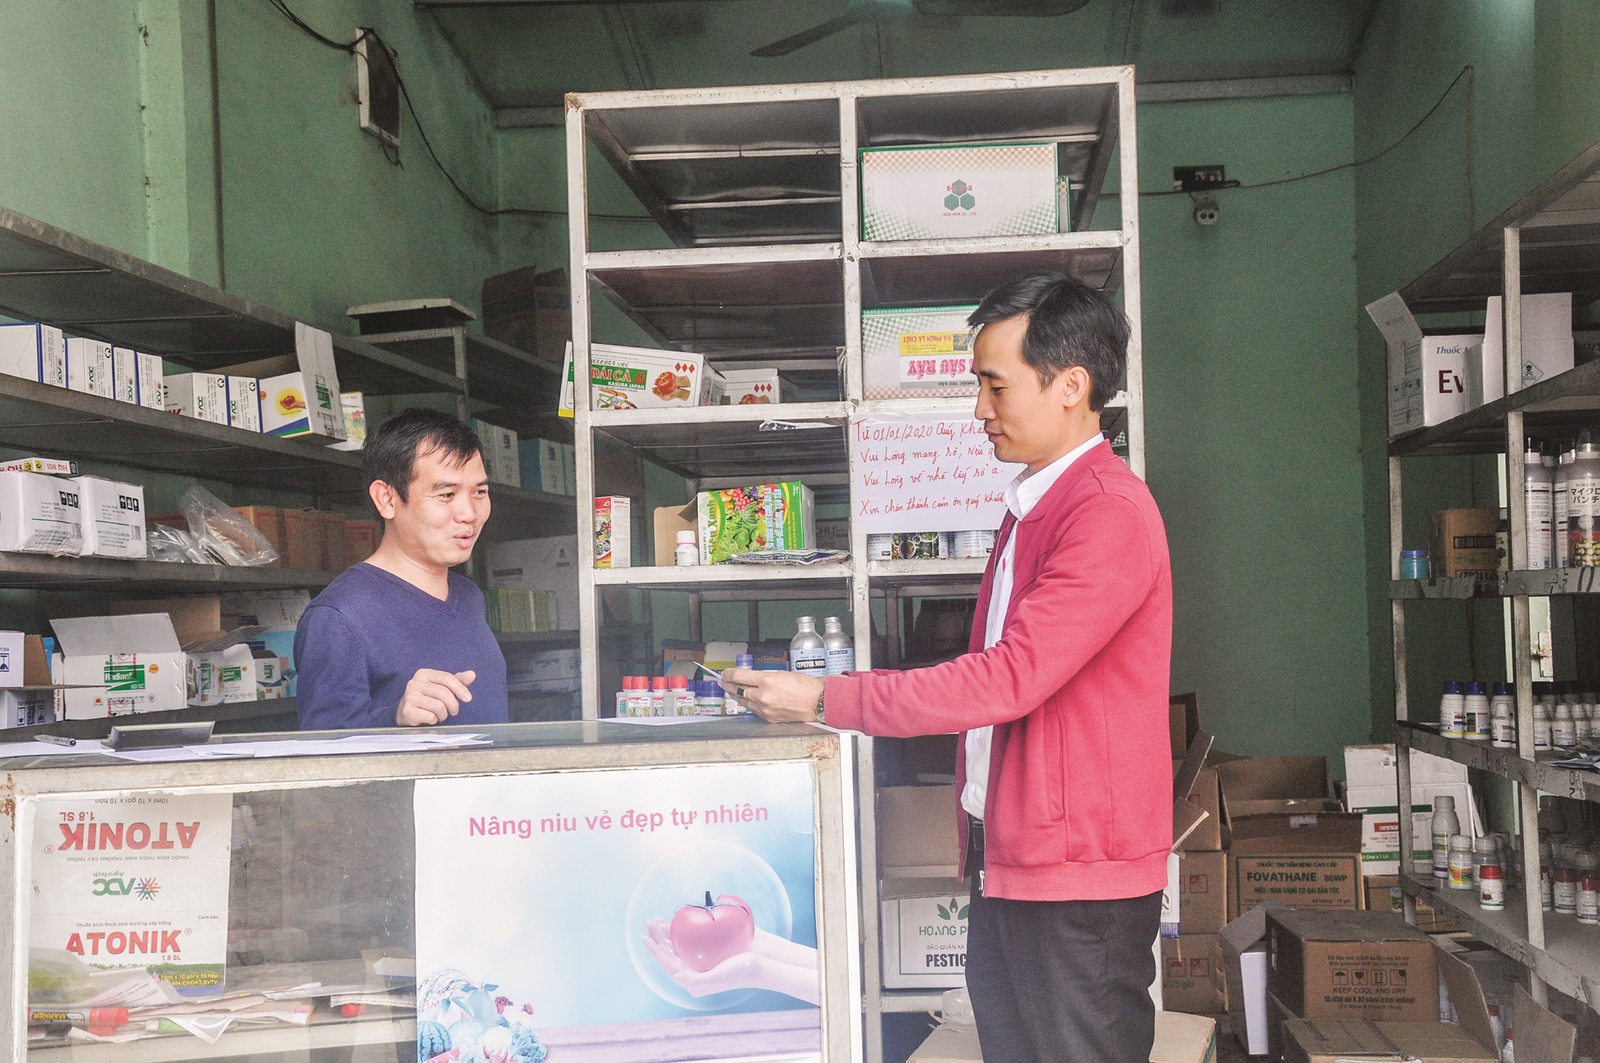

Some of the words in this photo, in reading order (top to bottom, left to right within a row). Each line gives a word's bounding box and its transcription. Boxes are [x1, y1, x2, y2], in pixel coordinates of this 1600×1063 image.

[1436, 344, 1461, 354] Thuốc
[939, 358, 966, 378] SÂU
[873, 424, 933, 442] 01/01/2020
[912, 450, 940, 464] mang
[1572, 496, 1600, 504] パンチ
[707, 498, 717, 528] Xanh
[859, 500, 879, 516] Xin
[59, 811, 75, 821] SL
[78, 811, 95, 821] 1.8
[468, 815, 532, 839] Nâng
[540, 812, 577, 833] niu
[585, 809, 612, 831] vẻ
[620, 808, 664, 833] đẹp
[670, 807, 698, 831] tự
[704, 803, 770, 825] nhiên
[58, 822, 201, 850] ATONIK
[1247, 872, 1317, 881] FOVATHANE
[92, 878, 136, 896] ADC
[960, 926, 968, 935] P
[65, 930, 182, 955] ATONIK
[926, 953, 966, 967] PESTIC
